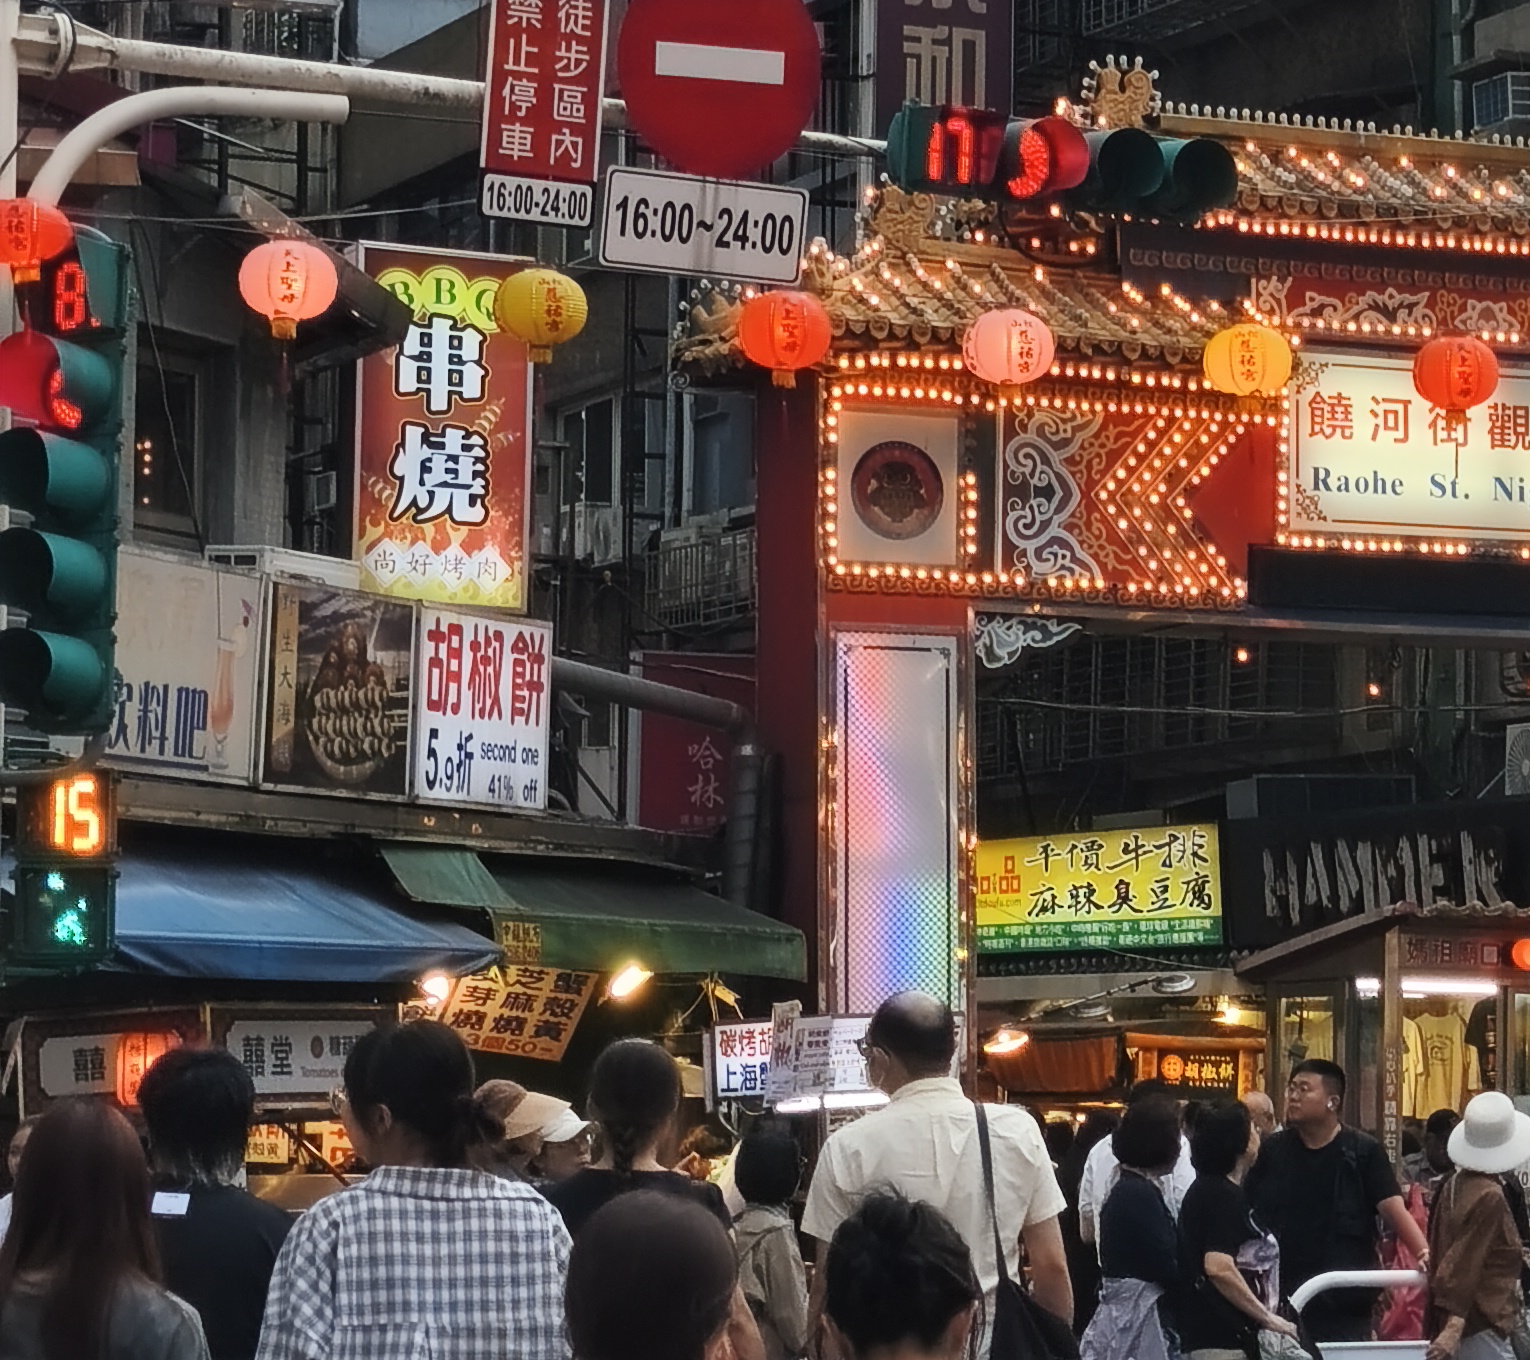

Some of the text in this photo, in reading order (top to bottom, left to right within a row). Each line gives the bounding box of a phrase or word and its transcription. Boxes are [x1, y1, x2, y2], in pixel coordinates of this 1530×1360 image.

[487, 180, 588, 222] 16:00-24:00
[615, 195, 795, 257] 16:00~24:00
[392, 315, 490, 527] 串燒
[1310, 466, 1405, 497] Raohe
[1429, 473, 1471, 500] St.
[374, 549, 499, 585] 尚好烤肉
[426, 615, 546, 728] 胡椒餅
[425, 727, 475, 797] 5.9折
[480, 739, 539, 766] second one
[686, 735, 725, 809] 哈林
[488, 774, 538, 803] 41% off
[49, 776, 101, 857] 15
[1025, 829, 1211, 874] 平價牛排
[1027, 872, 1214, 918] 麻辣臭豆腐
